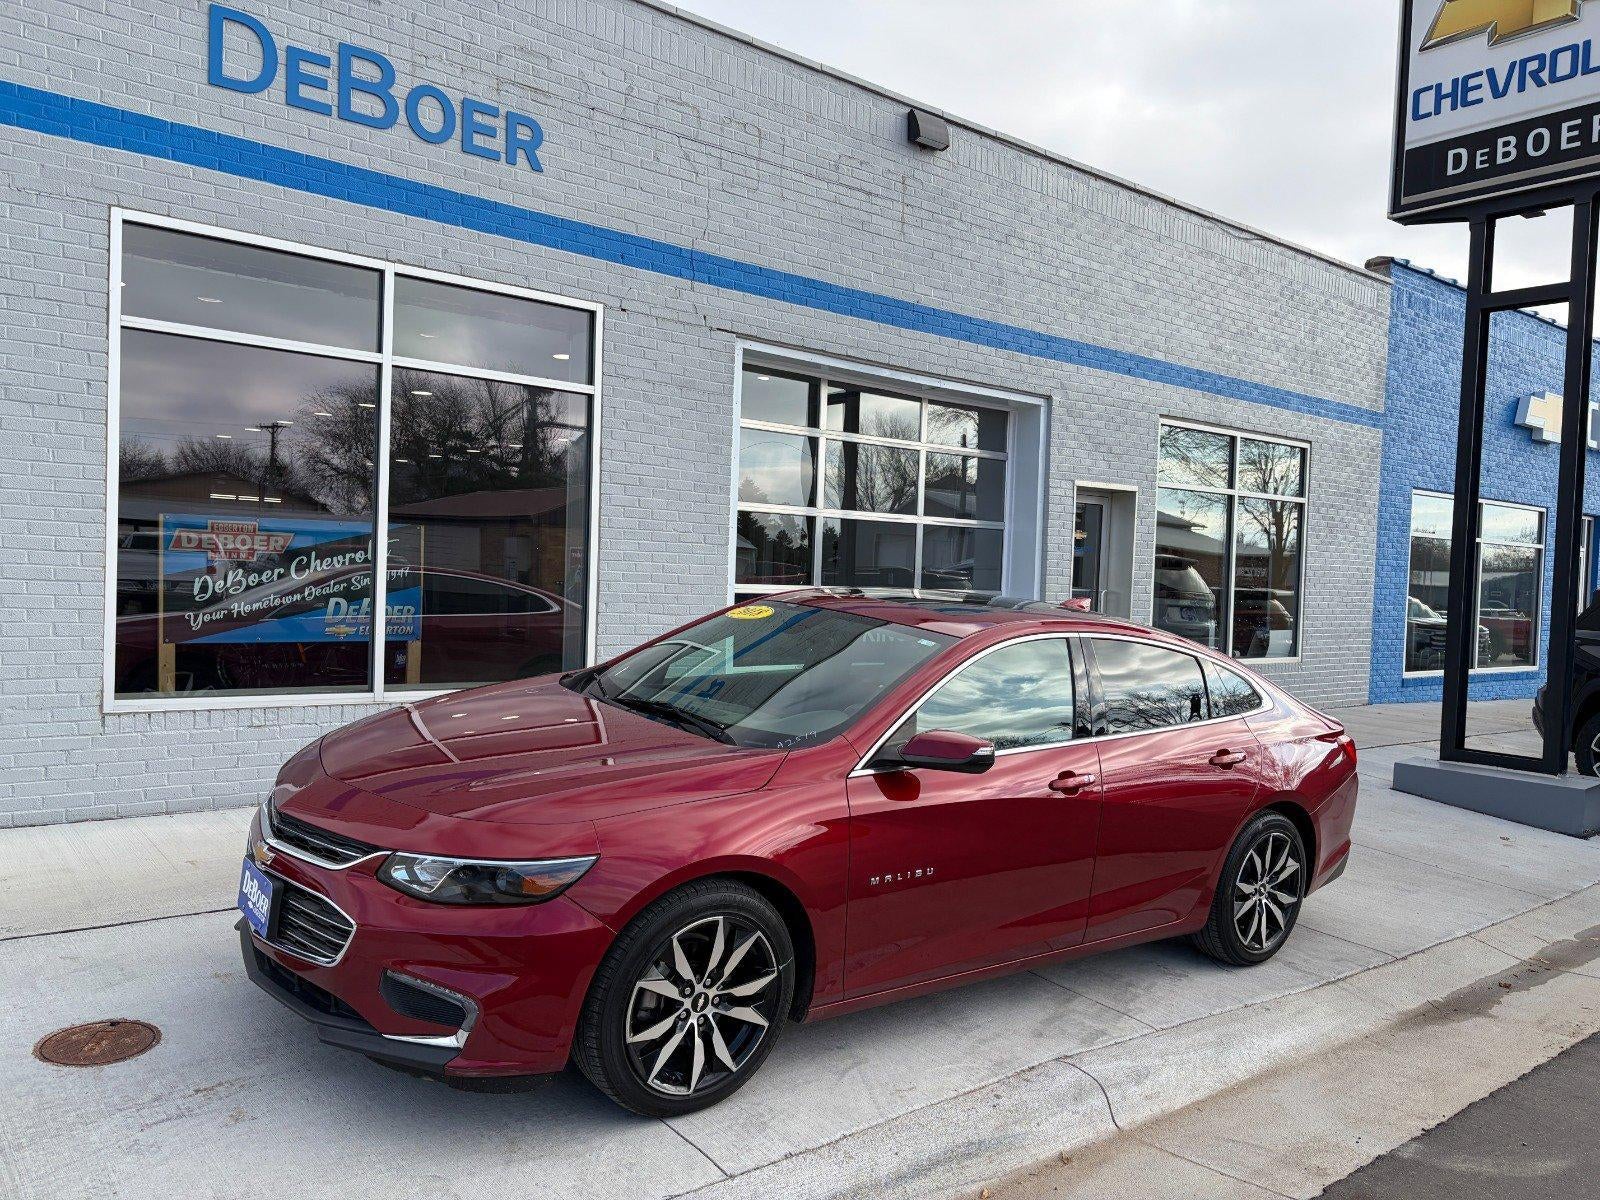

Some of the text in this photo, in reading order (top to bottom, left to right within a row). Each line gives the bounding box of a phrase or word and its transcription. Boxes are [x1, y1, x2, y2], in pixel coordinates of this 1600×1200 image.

[1411, 38, 1600, 122] CHEVROL
[181, 533, 285, 551] DEBOER
[193, 539, 400, 602] DeBoer Chevrol
[184, 609, 228, 631] Your
[230, 594, 302, 618] Hometown
[303, 579, 348, 601] Dealer
[358, 625, 414, 635] ERTON
[870, 867, 934, 885] MALIBU
